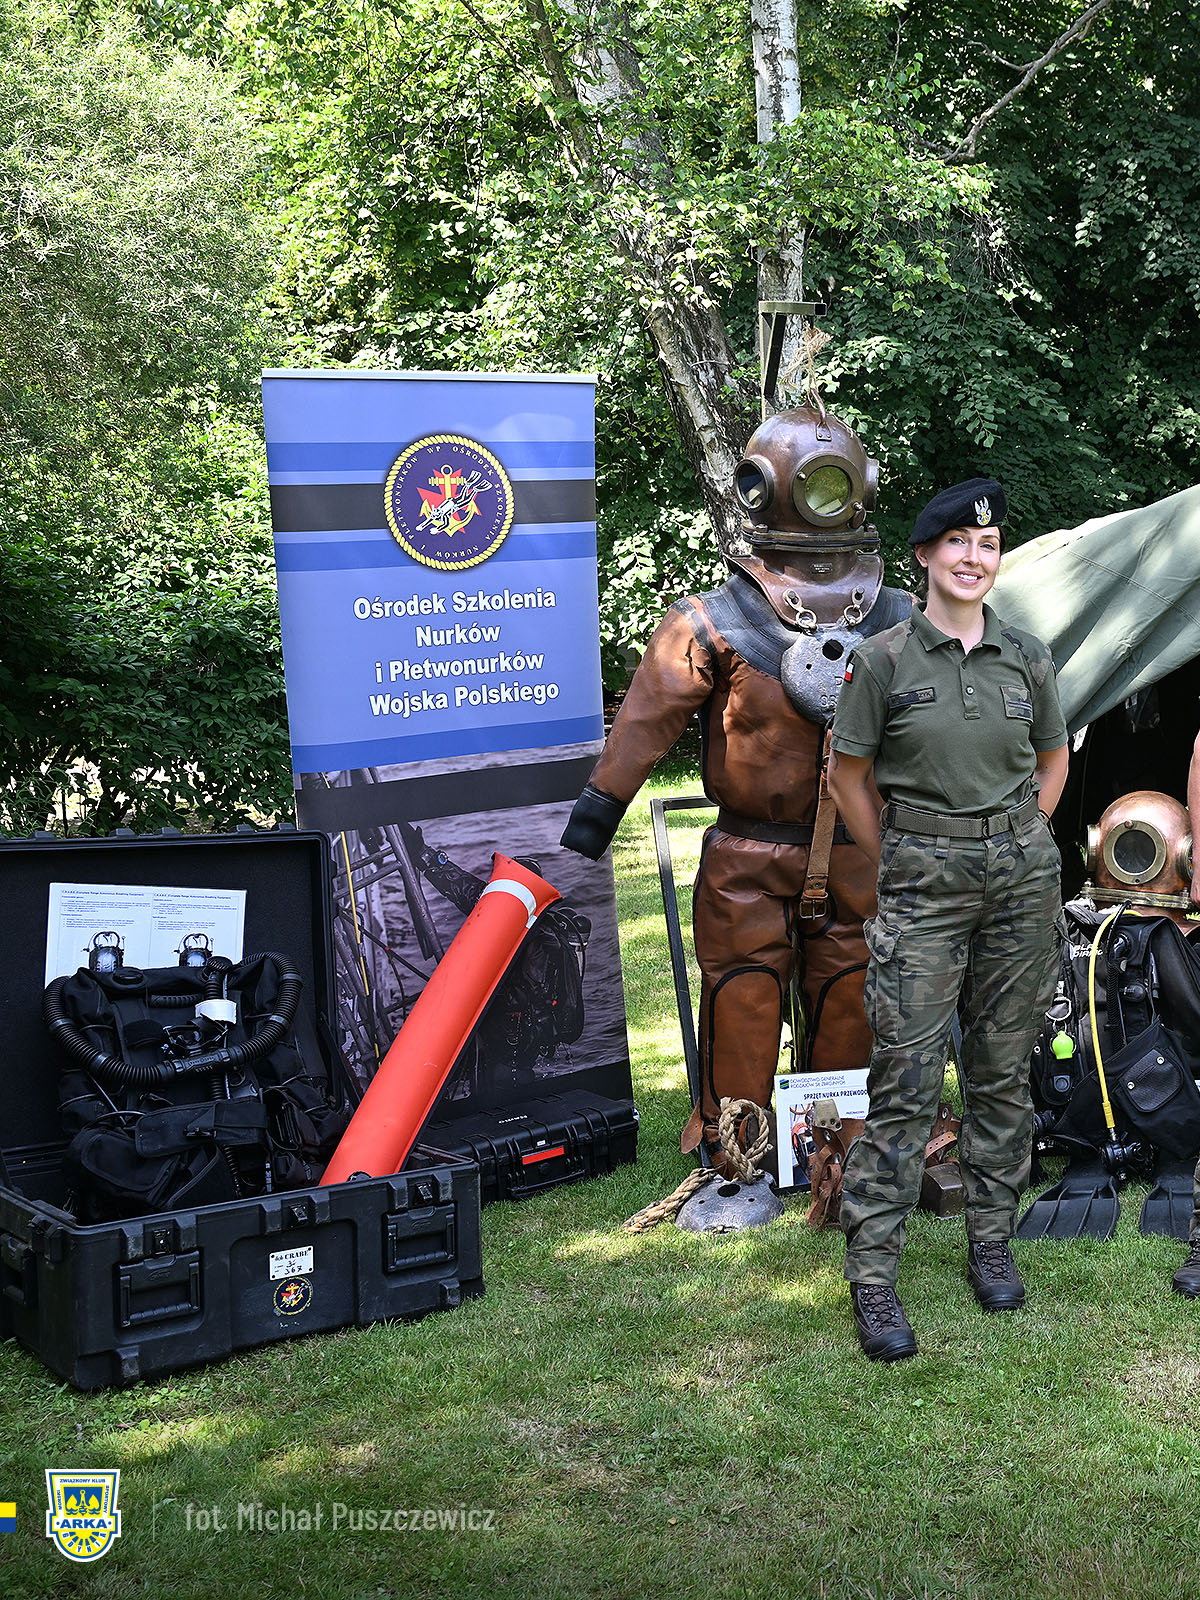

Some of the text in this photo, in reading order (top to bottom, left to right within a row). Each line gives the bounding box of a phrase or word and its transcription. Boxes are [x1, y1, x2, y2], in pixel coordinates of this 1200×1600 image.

[426, 446, 441, 454] WP
[452, 446, 494, 477] OŚRODEK
[485, 483, 504, 541] SZKOLENIA
[434, 544, 479, 559] NURKÓW
[353, 587, 557, 620] Ośrodek Szkolenia
[415, 622, 501, 647] Nurków
[375, 650, 545, 683] i Płetwonurków
[368, 681, 560, 719] Wojska Polskiego
[803, 1089, 868, 1101] SPRZĘT NURKA PRZEWODO
